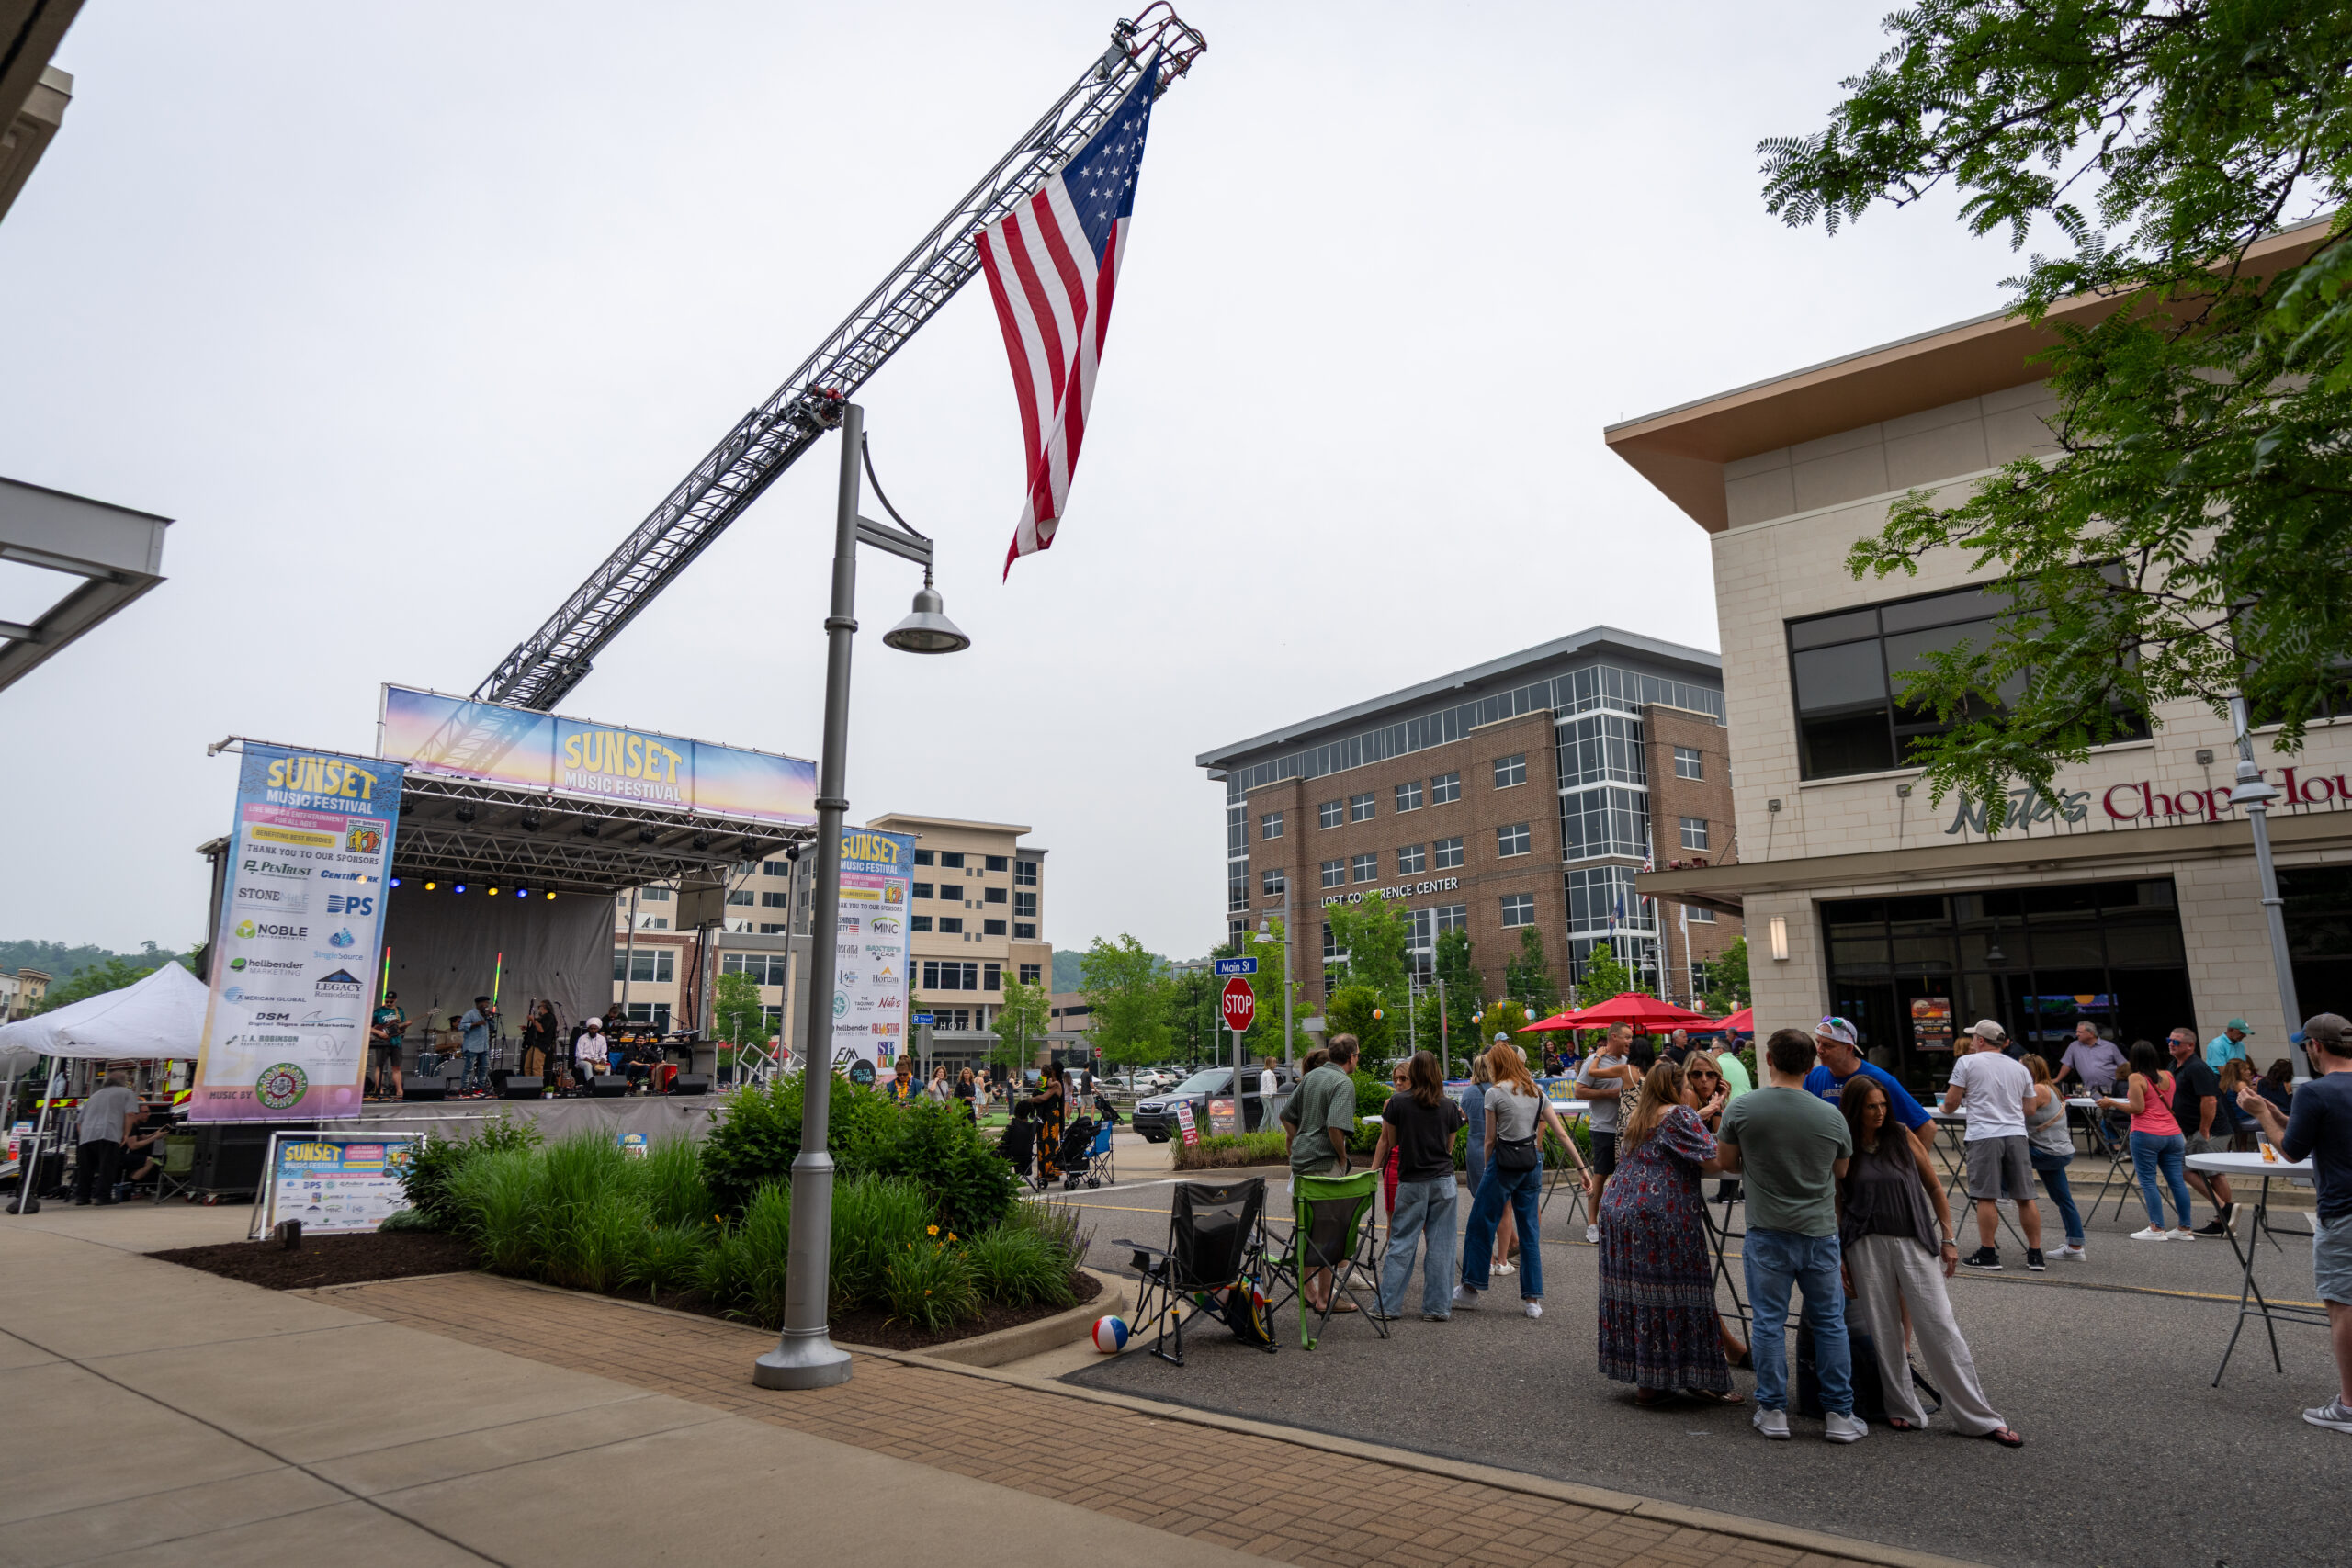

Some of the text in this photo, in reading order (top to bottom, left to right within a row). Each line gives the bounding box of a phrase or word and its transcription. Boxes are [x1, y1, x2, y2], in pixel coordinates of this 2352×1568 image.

[564, 731, 683, 784] SUNSET
[267, 757, 378, 800] SUNSET
[565, 771, 682, 802] MUSIC FESTIVAL
[266, 789, 373, 815] MUSIC FESTIVAL
[2103, 780, 2233, 822] Chop
[275, 816, 288, 824] FOR
[300, 819, 317, 828] AGES
[291, 811, 345, 822] ENTERTAINMENT
[255, 829, 288, 840] BENEFITING
[305, 835, 333, 844] BUDDIES
[246, 844, 379, 865] THANK YOU TO OUR SPONSORS
[841, 833, 900, 863] SUNSET
[840, 860, 898, 874] MUSIC FESTIVAL
[1321, 877, 1458, 908] LOFT CONRENCE CENTER
[327, 894, 374, 916] DPS
[258, 924, 309, 937] NOBLE
[874, 923, 899, 934] MINC
[313, 950, 364, 961] SingleSource
[837, 944, 858, 954] oscana
[249, 959, 305, 969] hellbender
[1221, 961, 1250, 973] Main St
[249, 967, 301, 976] MARKETING
[872, 974, 899, 984] Horizon
[315, 983, 364, 992] LEGACY
[314, 990, 361, 1000] Remodeling
[878, 995, 901, 1009] Nate's
[1225, 994, 1252, 1014] STOP
[255, 1012, 290, 1021] DSM
[886, 1023, 899, 1034] STAR
[209, 1091, 236, 1100] MUSIC
[285, 1143, 342, 1162] SUNSET
